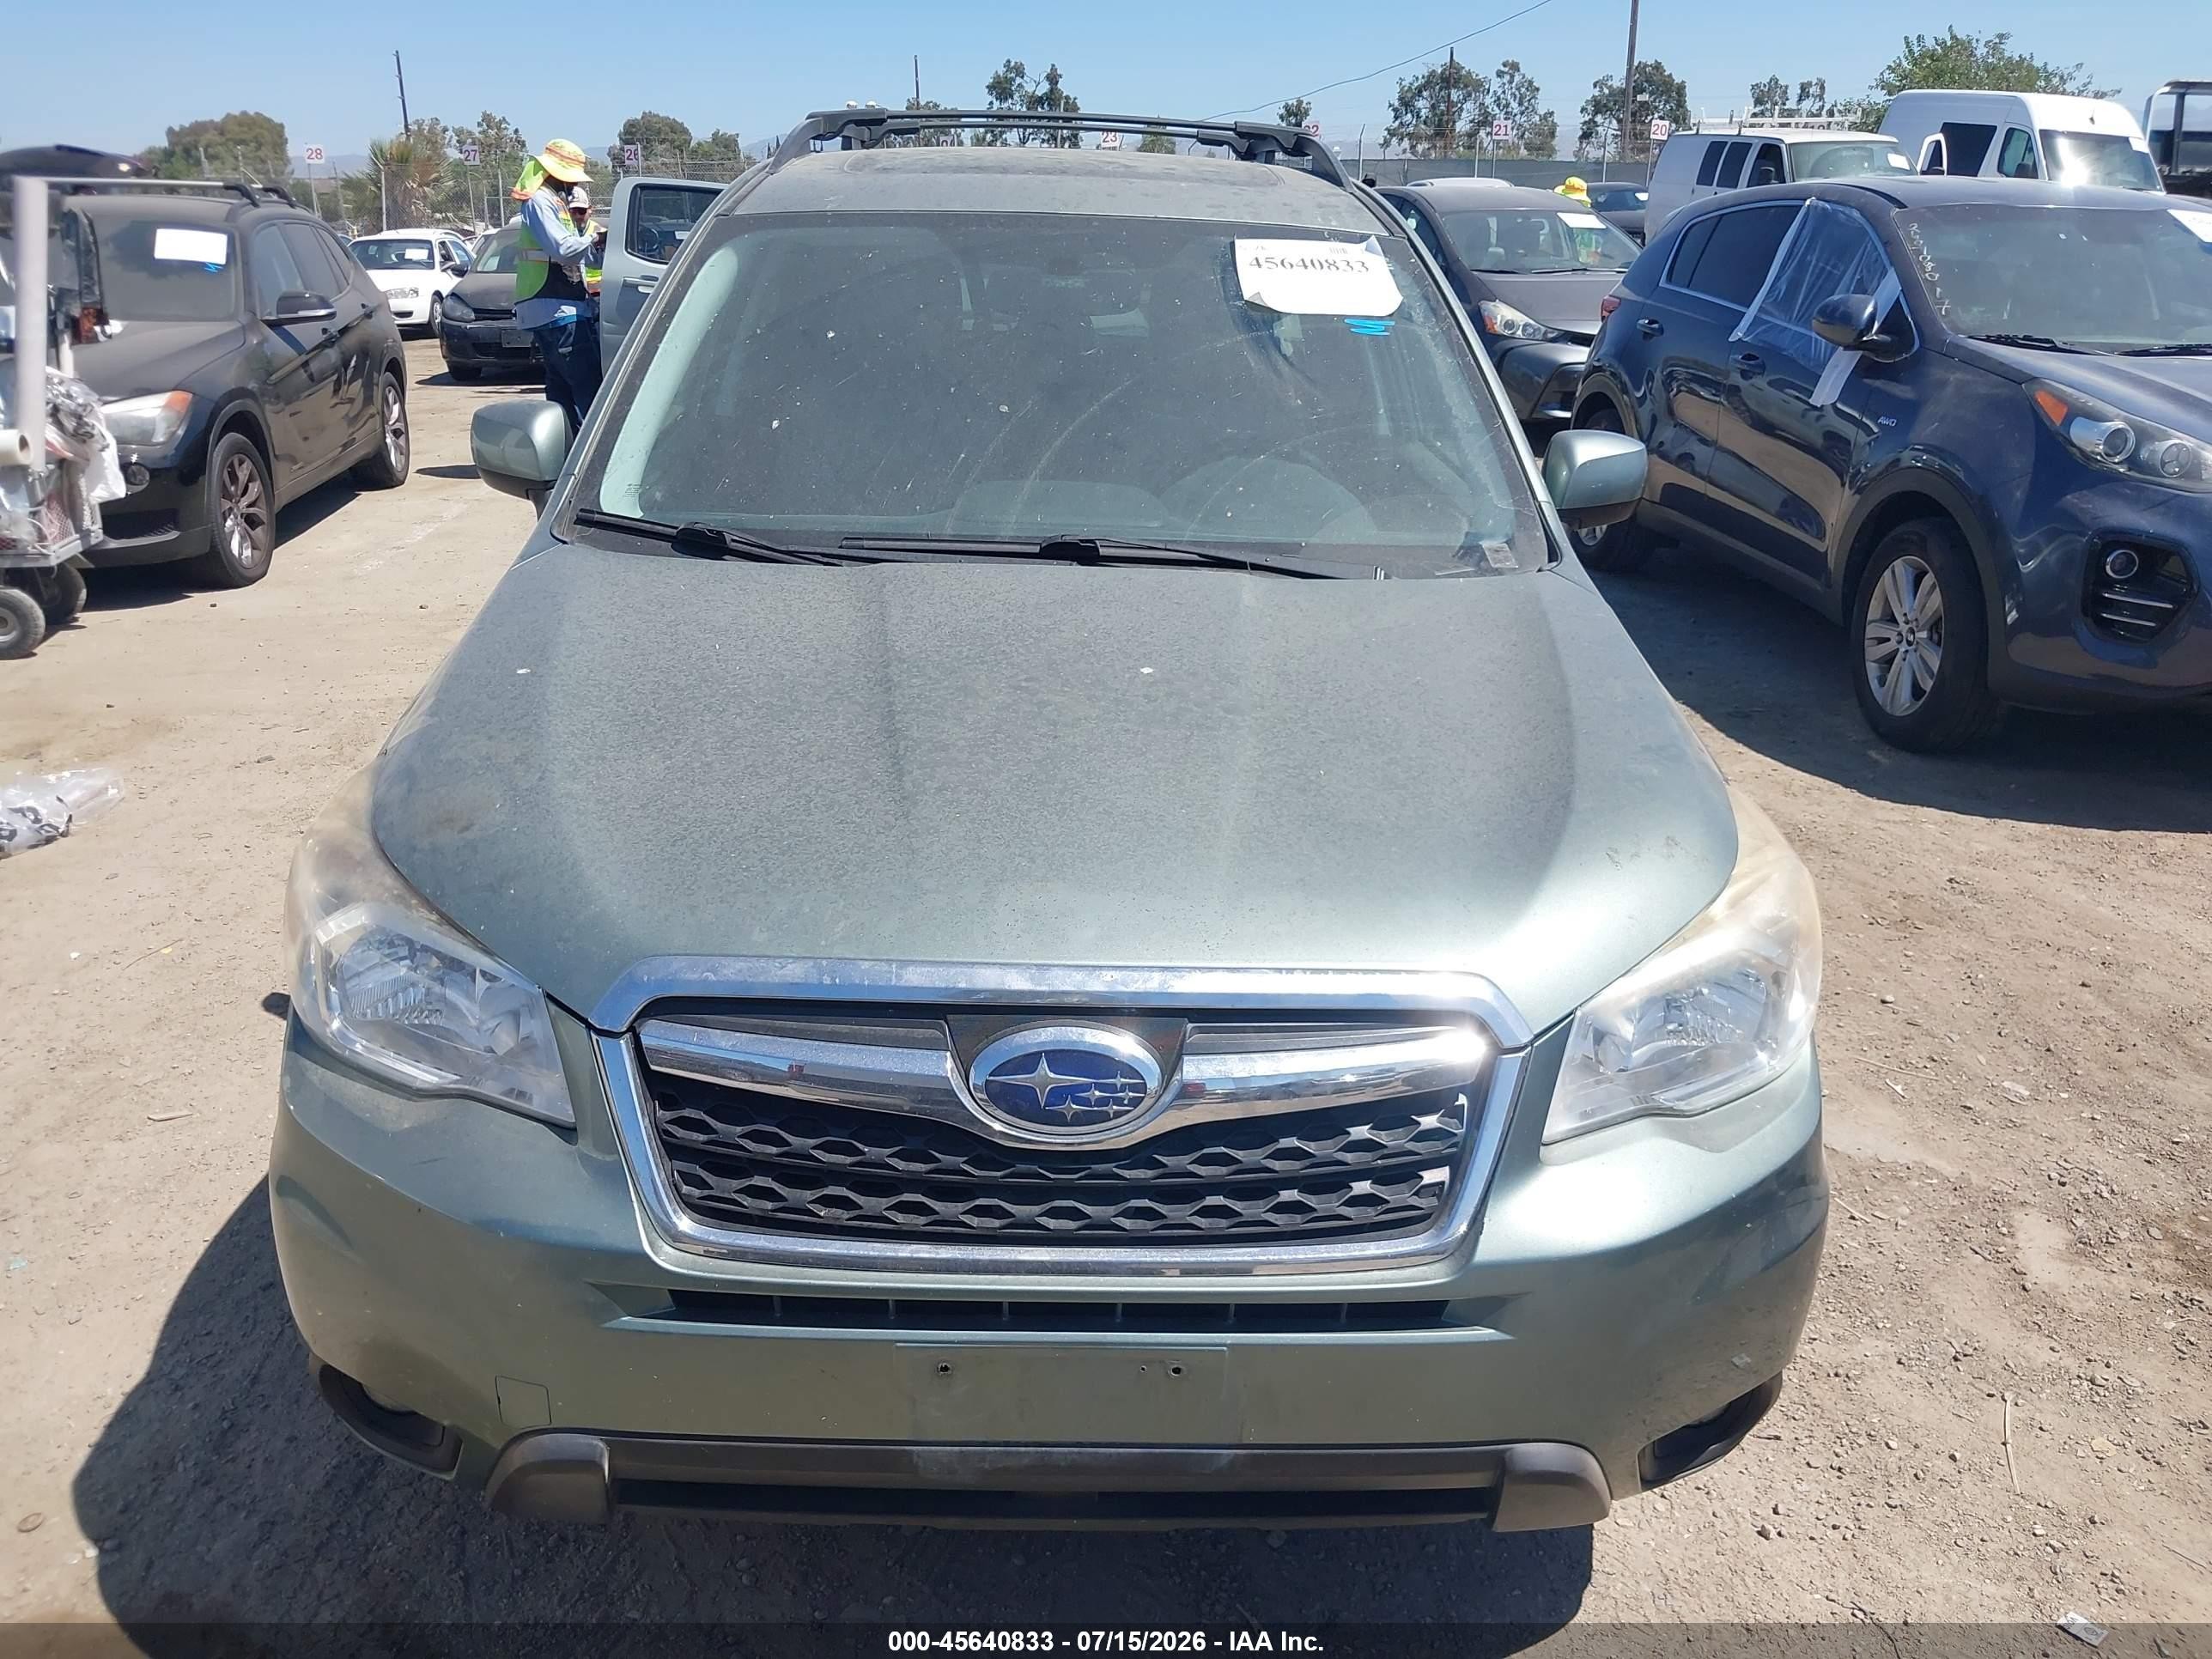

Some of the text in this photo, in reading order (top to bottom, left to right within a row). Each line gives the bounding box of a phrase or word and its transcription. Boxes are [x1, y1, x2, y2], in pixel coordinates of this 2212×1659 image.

[1494, 124, 1509, 136] 21
[1652, 124, 1668, 136] 20
[1102, 131, 1117, 143] 23
[306, 148, 324, 160] 28
[464, 149, 478, 161] 27
[1249, 256, 1370, 273] 45640833
[1877, 416, 1897, 427] AWD
